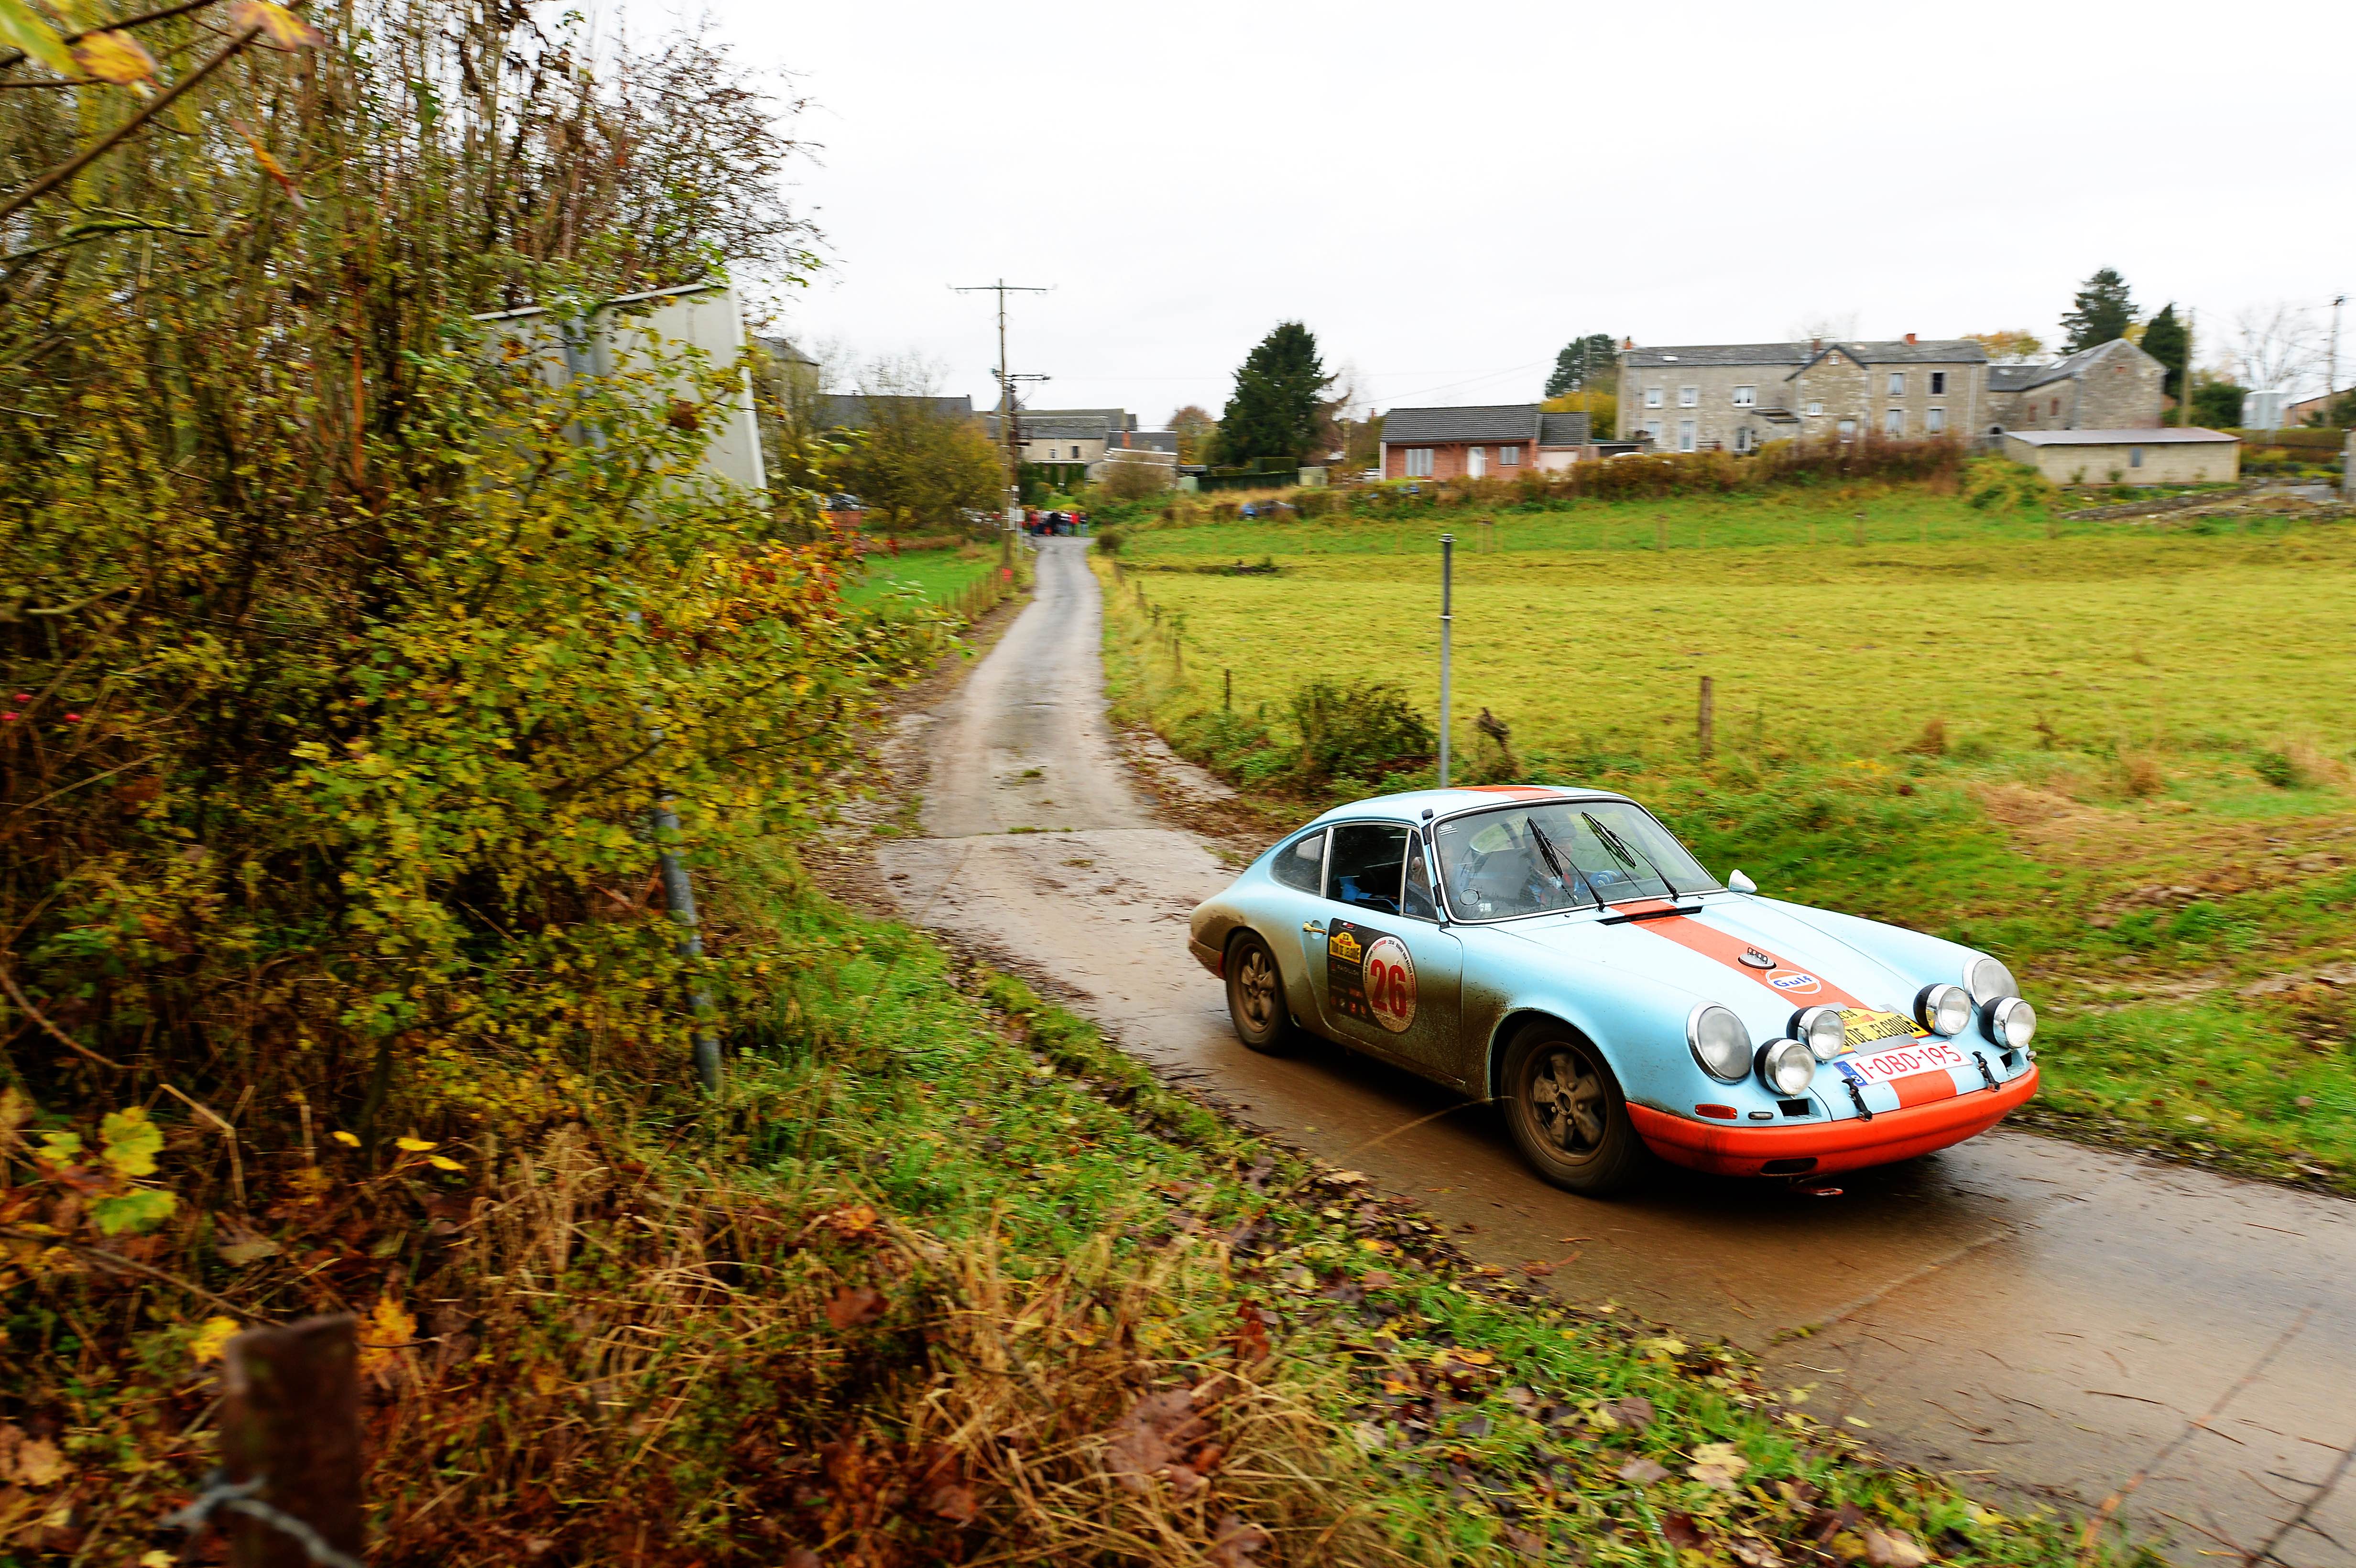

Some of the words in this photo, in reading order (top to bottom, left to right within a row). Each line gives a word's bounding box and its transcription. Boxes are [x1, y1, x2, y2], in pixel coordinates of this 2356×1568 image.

[1370, 958, 1407, 1018] 26
[1773, 976, 1812, 987] Gulf
[1845, 1028, 1873, 1043] DE
[1855, 1045, 1962, 1079] 1-OBD-195
